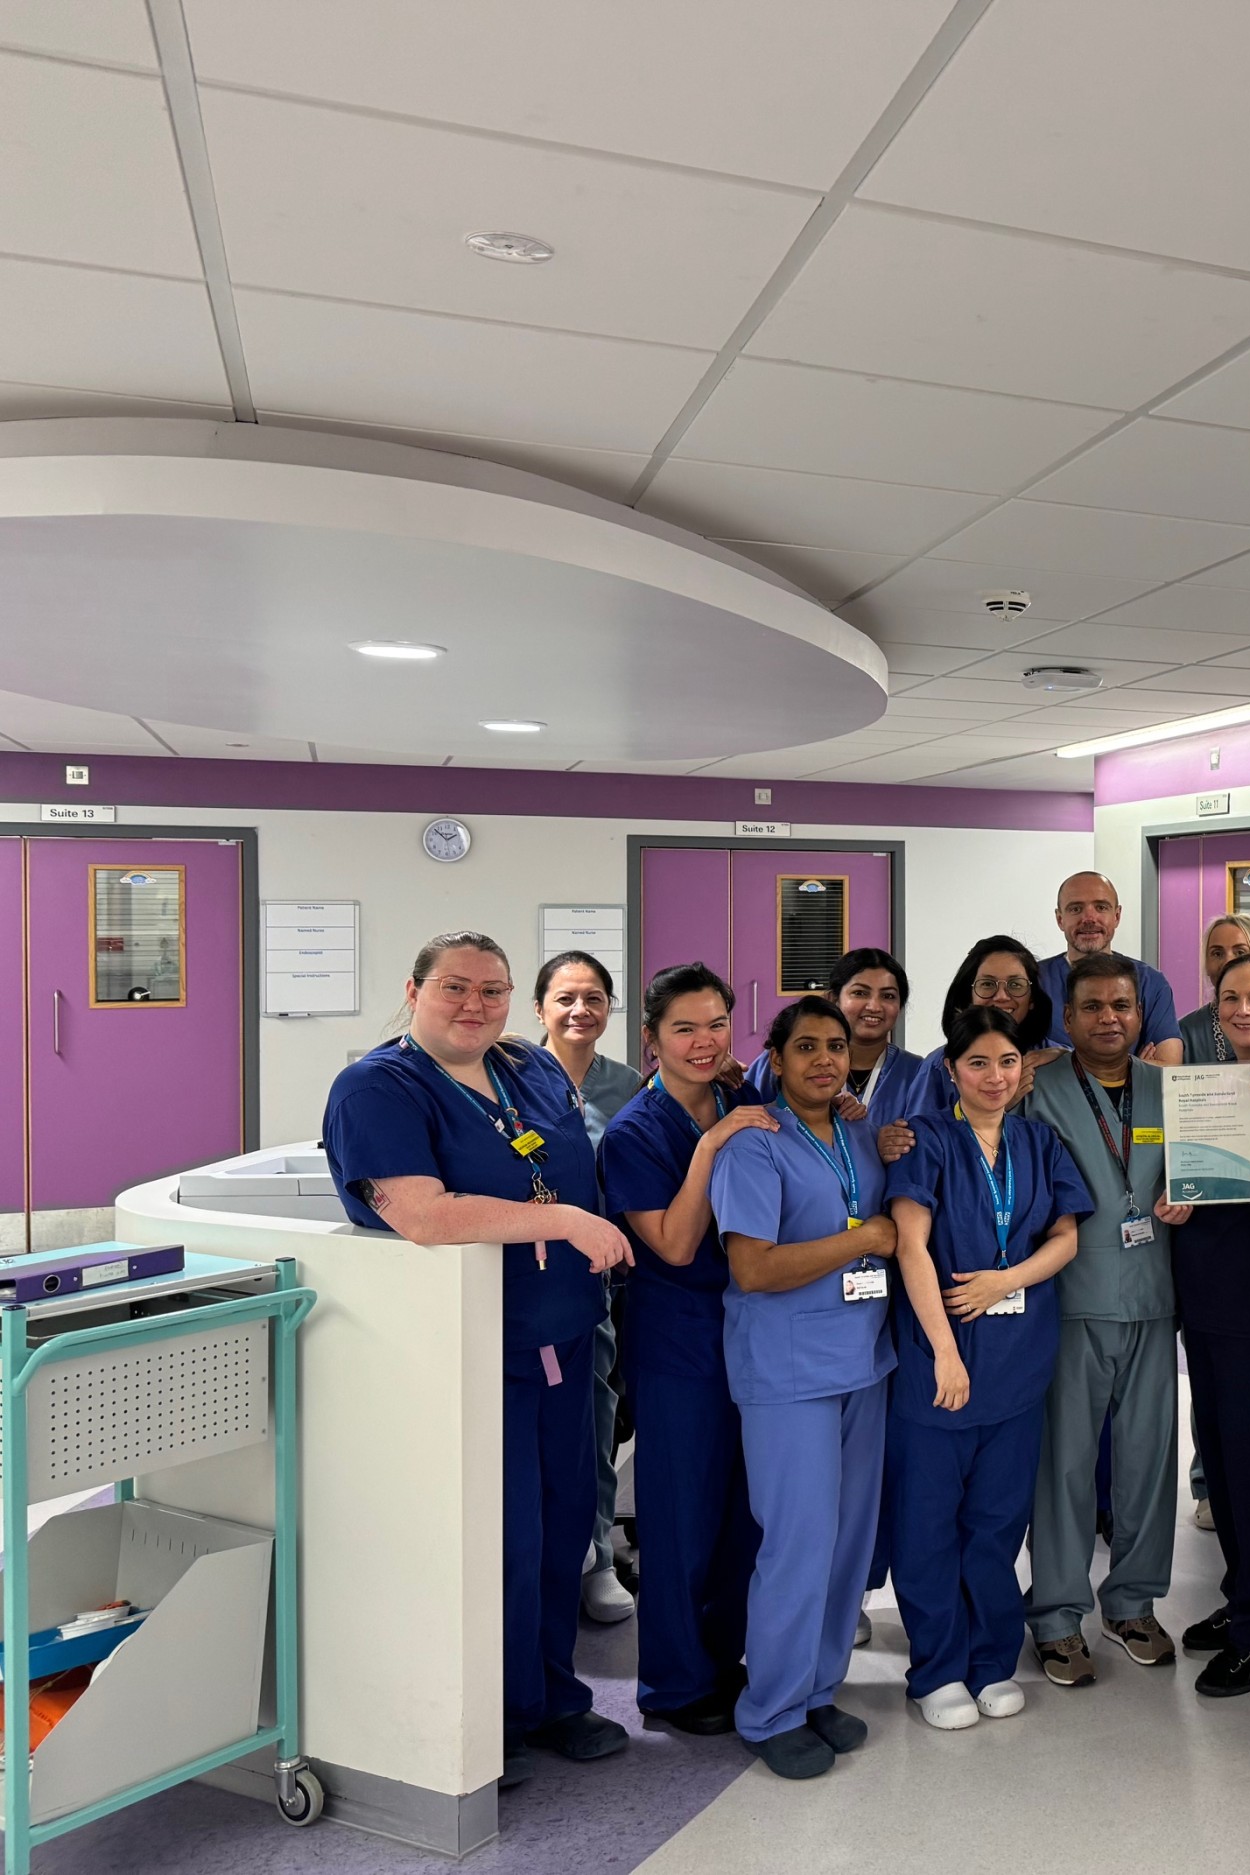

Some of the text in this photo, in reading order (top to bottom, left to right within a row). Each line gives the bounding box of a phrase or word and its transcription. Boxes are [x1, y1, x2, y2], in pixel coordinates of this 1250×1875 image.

[50, 809, 94, 818] Suite 13
[742, 824, 763, 832] Suite
